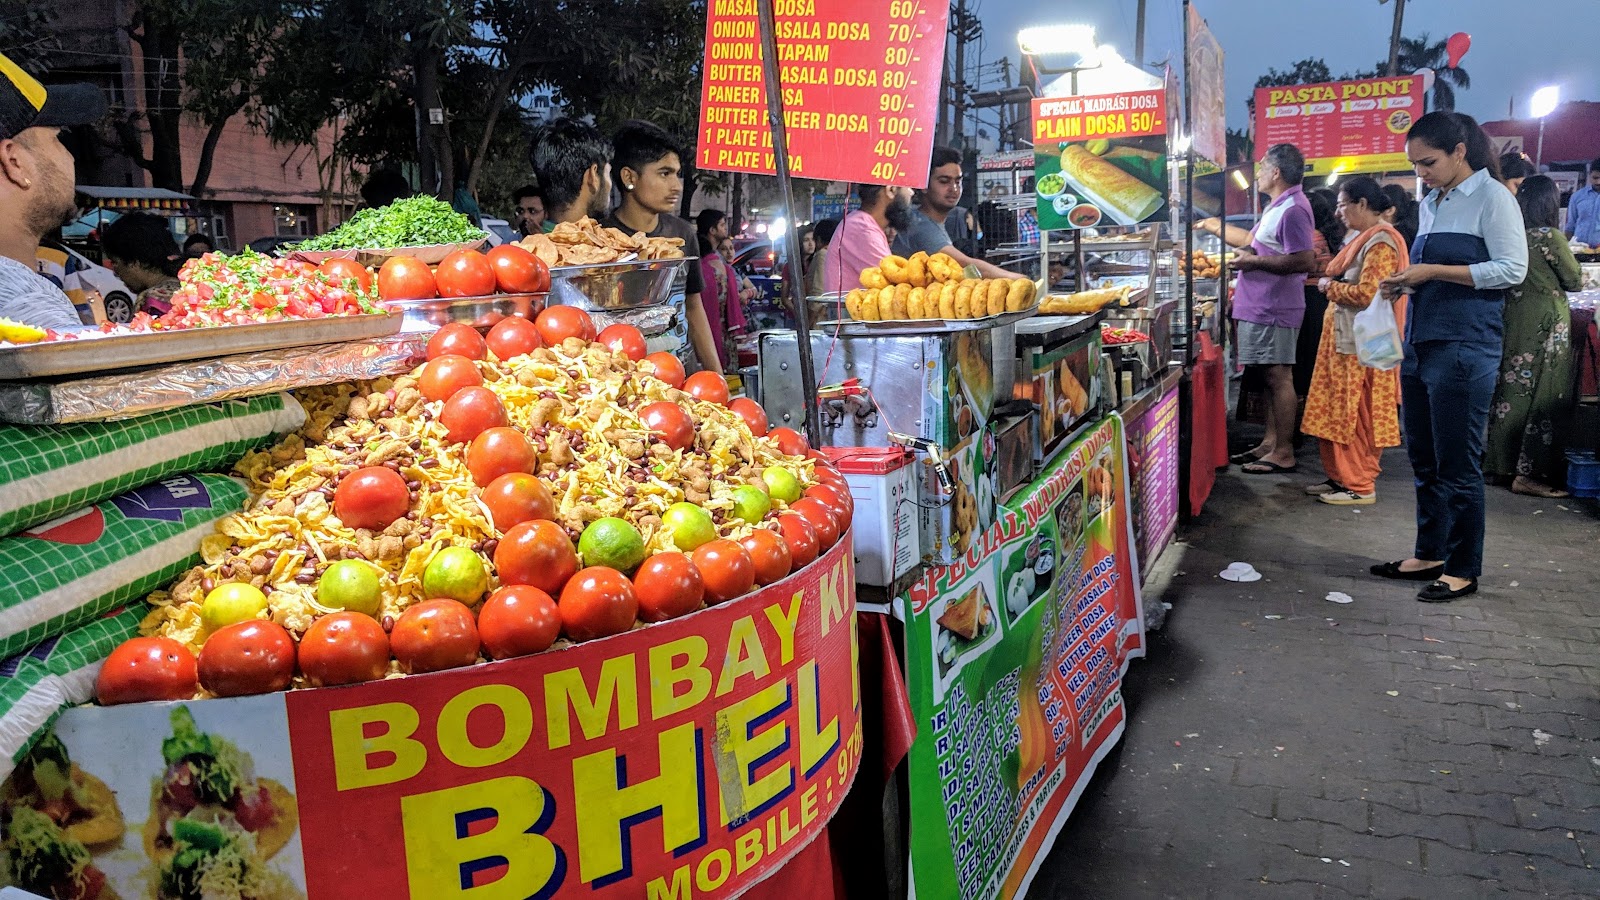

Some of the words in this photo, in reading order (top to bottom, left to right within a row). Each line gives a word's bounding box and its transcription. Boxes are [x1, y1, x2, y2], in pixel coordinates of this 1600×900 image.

[714, 0, 759, 17] MASAL
[775, 0, 815, 17] DOSA
[889, 0, 926, 21] 60/-
[713, 21, 755, 39] ONION
[775, 21, 821, 40] ASALA
[827, 22, 870, 42] DOSA
[888, 24, 924, 45] 70/-
[711, 42, 754, 60] ONION
[758, 43, 829, 62] TAPAM
[885, 48, 921, 68] 80/-
[709, 64, 762, 82] BUTTER
[780, 66, 829, 85] ASALA
[834, 68, 878, 88] DOSA
[882, 70, 918, 91] 80/-
[1269, 86, 1338, 105] PASTA
[1341, 79, 1414, 100] POINT
[708, 85, 759, 104] PANEER
[764, 88, 804, 107] SA
[879, 94, 915, 113] 90/-
[1039, 100, 1082, 117] SPECIAL
[1131, 95, 1158, 109] DOSA
[706, 106, 758, 125] BUTTER
[762, 109, 820, 130] PNEER
[826, 113, 869, 133] DOSA
[878, 117, 923, 138] 100/-
[1036, 116, 1081, 140] PLAIN
[1085, 113, 1127, 136] DOSA
[1131, 111, 1162, 133] 50/-
[705, 128, 712, 144] 1
[716, 129, 759, 148] PLATE
[874, 140, 909, 160] 40/-
[703, 148, 710, 165] 1
[718, 150, 760, 169] PLATE
[765, 153, 803, 173] VDA
[871, 162, 906, 182] 40/-
[160, 475, 200, 499] RA
[908, 512, 1026, 613] SPECIAL
[1022, 451, 1087, 532] MADRASI
[1087, 416, 1114, 467] DOSA
[1075, 577, 1112, 616] MASALA
[1081, 602, 1107, 632] DOSA
[329, 587, 806, 792] BOMBAY
[819, 552, 856, 638] KI
[1058, 638, 1092, 678] BUTTER
[1066, 669, 1088, 695] VEG.
[1085, 644, 1108, 675] DOSA
[1074, 675, 1097, 712] ONION
[1045, 696, 1064, 725] 80/-
[1002, 724, 1023, 762] PCS)
[1052, 714, 1070, 743] 80/-
[401, 657, 841, 900] BHEL
[645, 782, 819, 900] MOBILE
[837, 708, 863, 786] 978
[974, 775, 1005, 841] UTTPAM
[981, 786, 1014, 852] UTTPAM
[996, 816, 1030, 885] MARRIAGES
[1030, 806, 1036, 821] &
[1035, 768, 1061, 811] PARTIES
[983, 812, 1015, 877] PANEER
